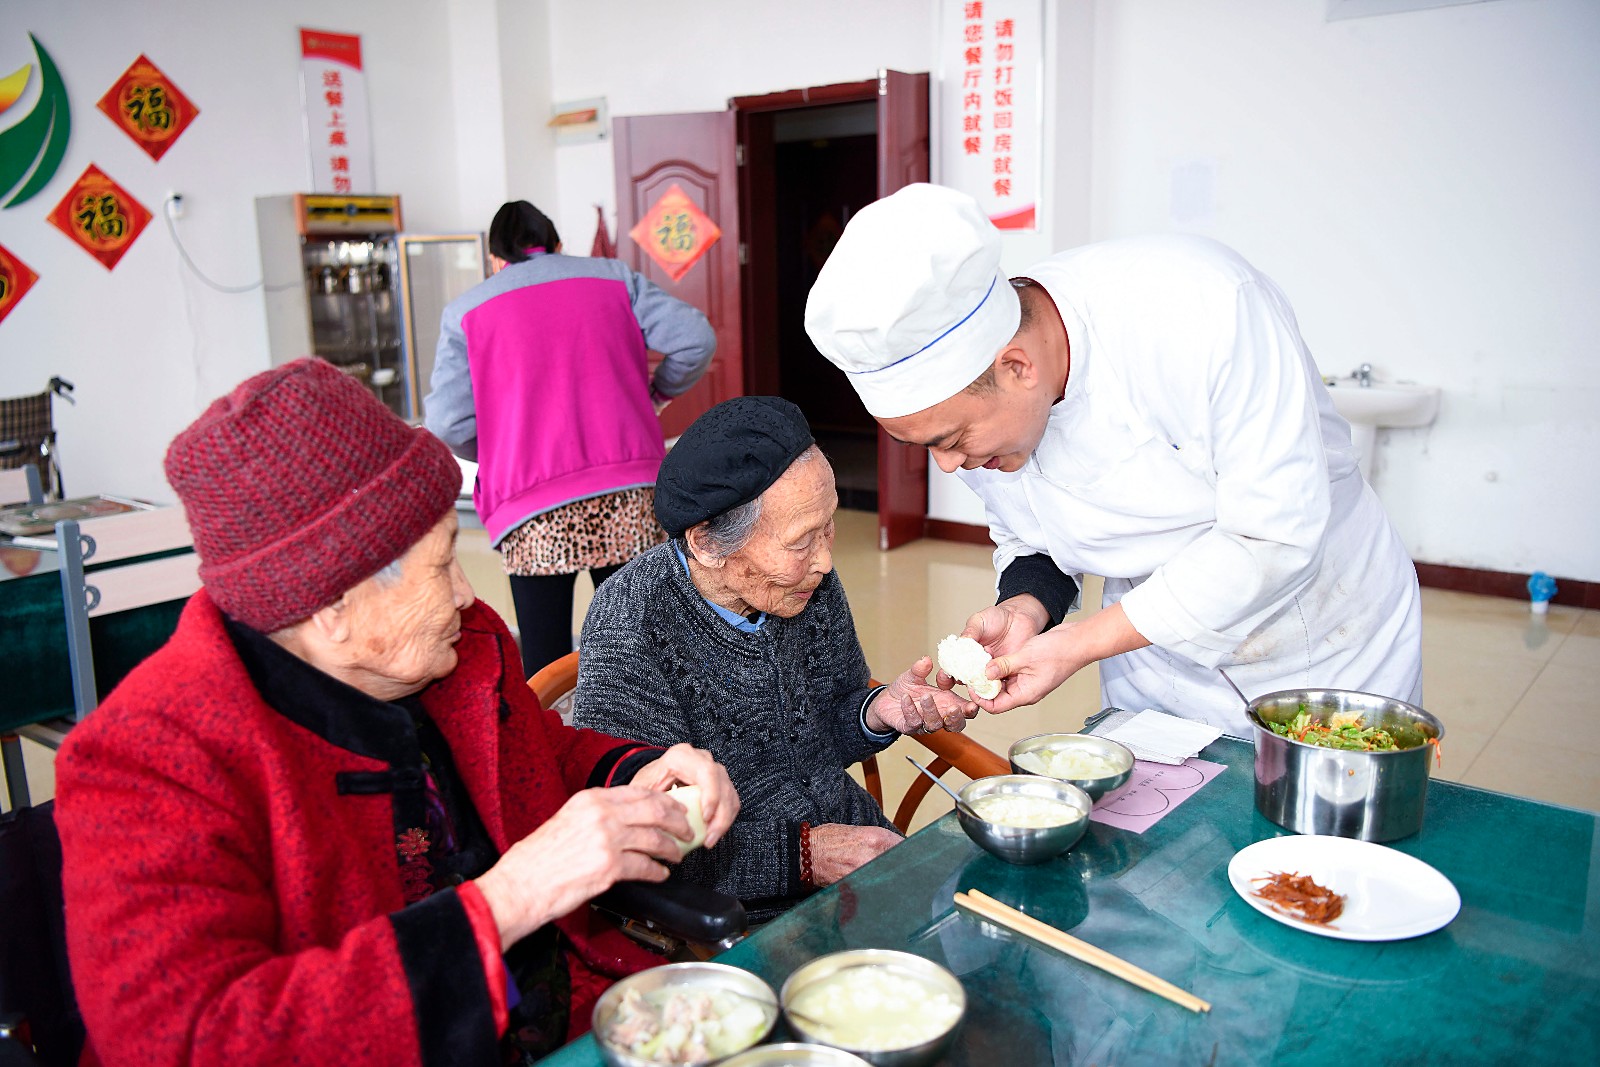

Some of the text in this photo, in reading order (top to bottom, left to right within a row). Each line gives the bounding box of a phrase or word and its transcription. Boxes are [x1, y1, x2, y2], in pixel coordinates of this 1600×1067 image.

[963, 1, 982, 154] 请您餐厅内就餐
[126, 85, 171, 130] 福
[993, 19, 1013, 197] 请勿打饭回房就餐
[77, 193, 124, 240] 福
[656, 213, 693, 252] 福
